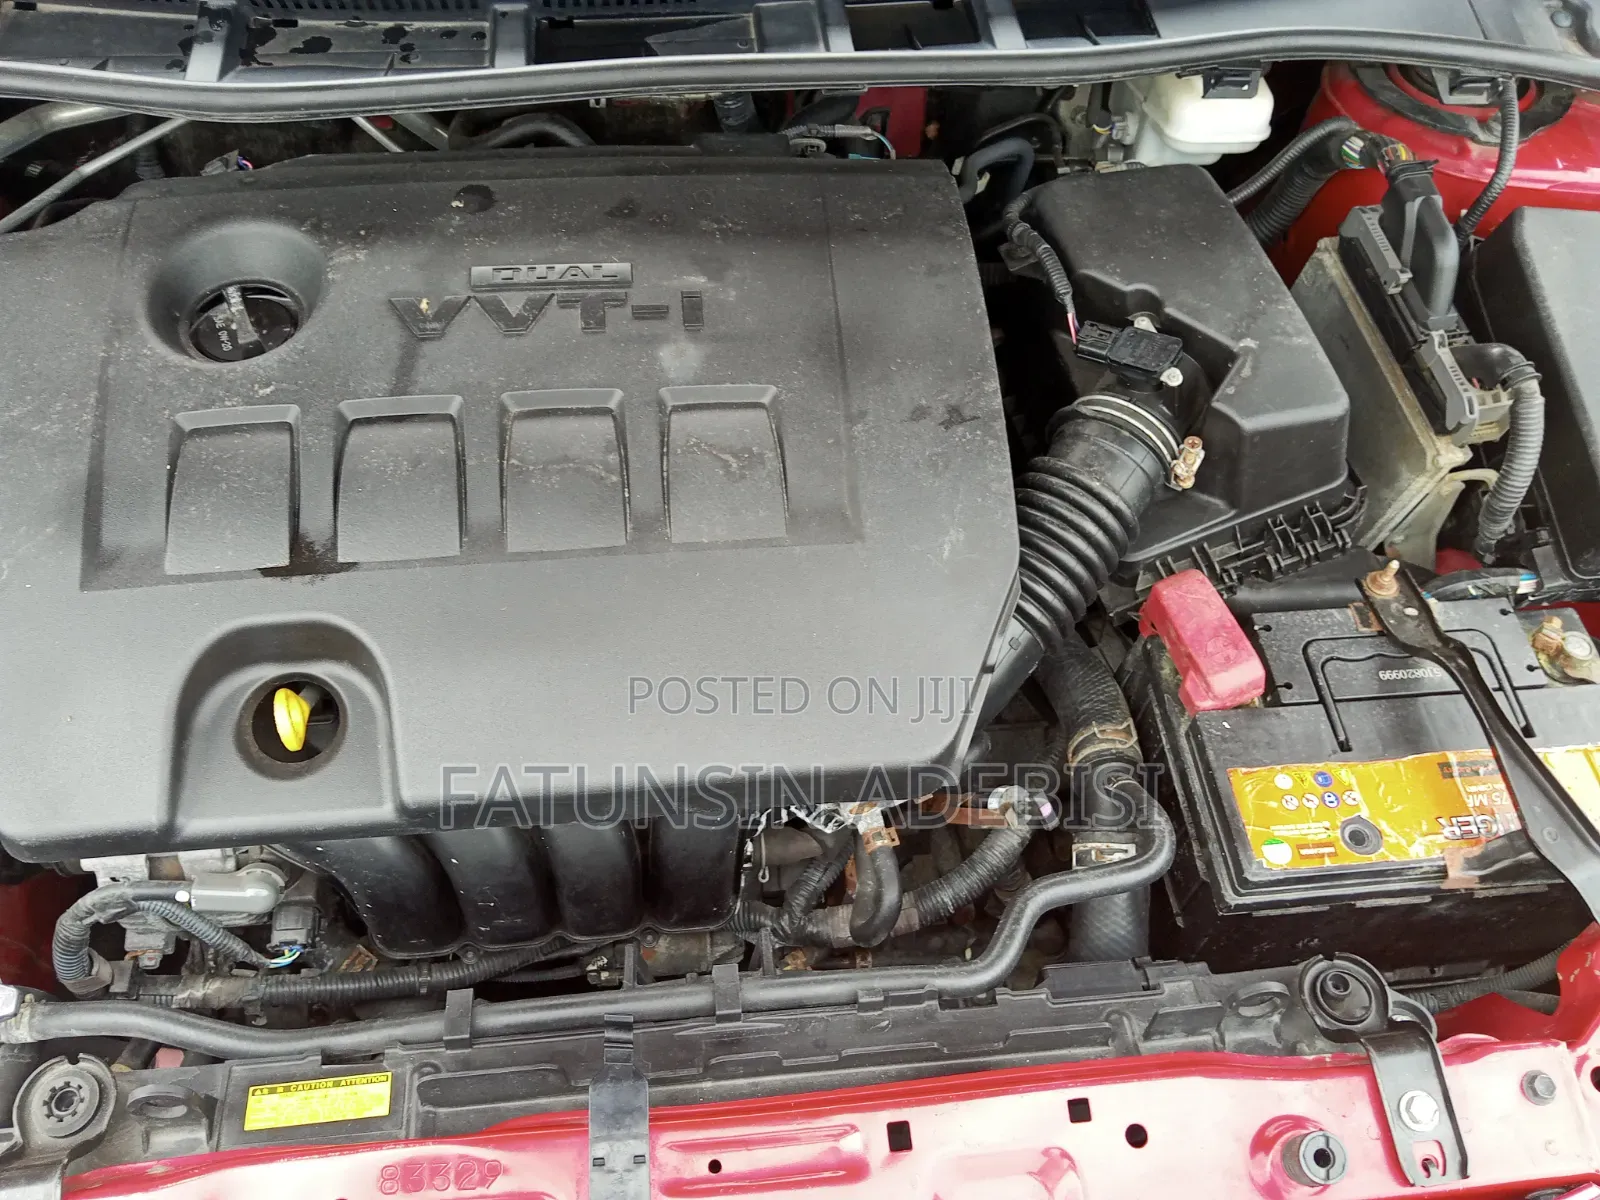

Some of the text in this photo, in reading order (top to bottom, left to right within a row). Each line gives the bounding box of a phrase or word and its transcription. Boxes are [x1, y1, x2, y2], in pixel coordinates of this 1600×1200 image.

[491, 264, 621, 281] DUAL
[217, 330, 233, 352] 0W-20
[290, 1075, 388, 1092] CAUTION ATTENTION
[380, 1159, 504, 1196] 83329
